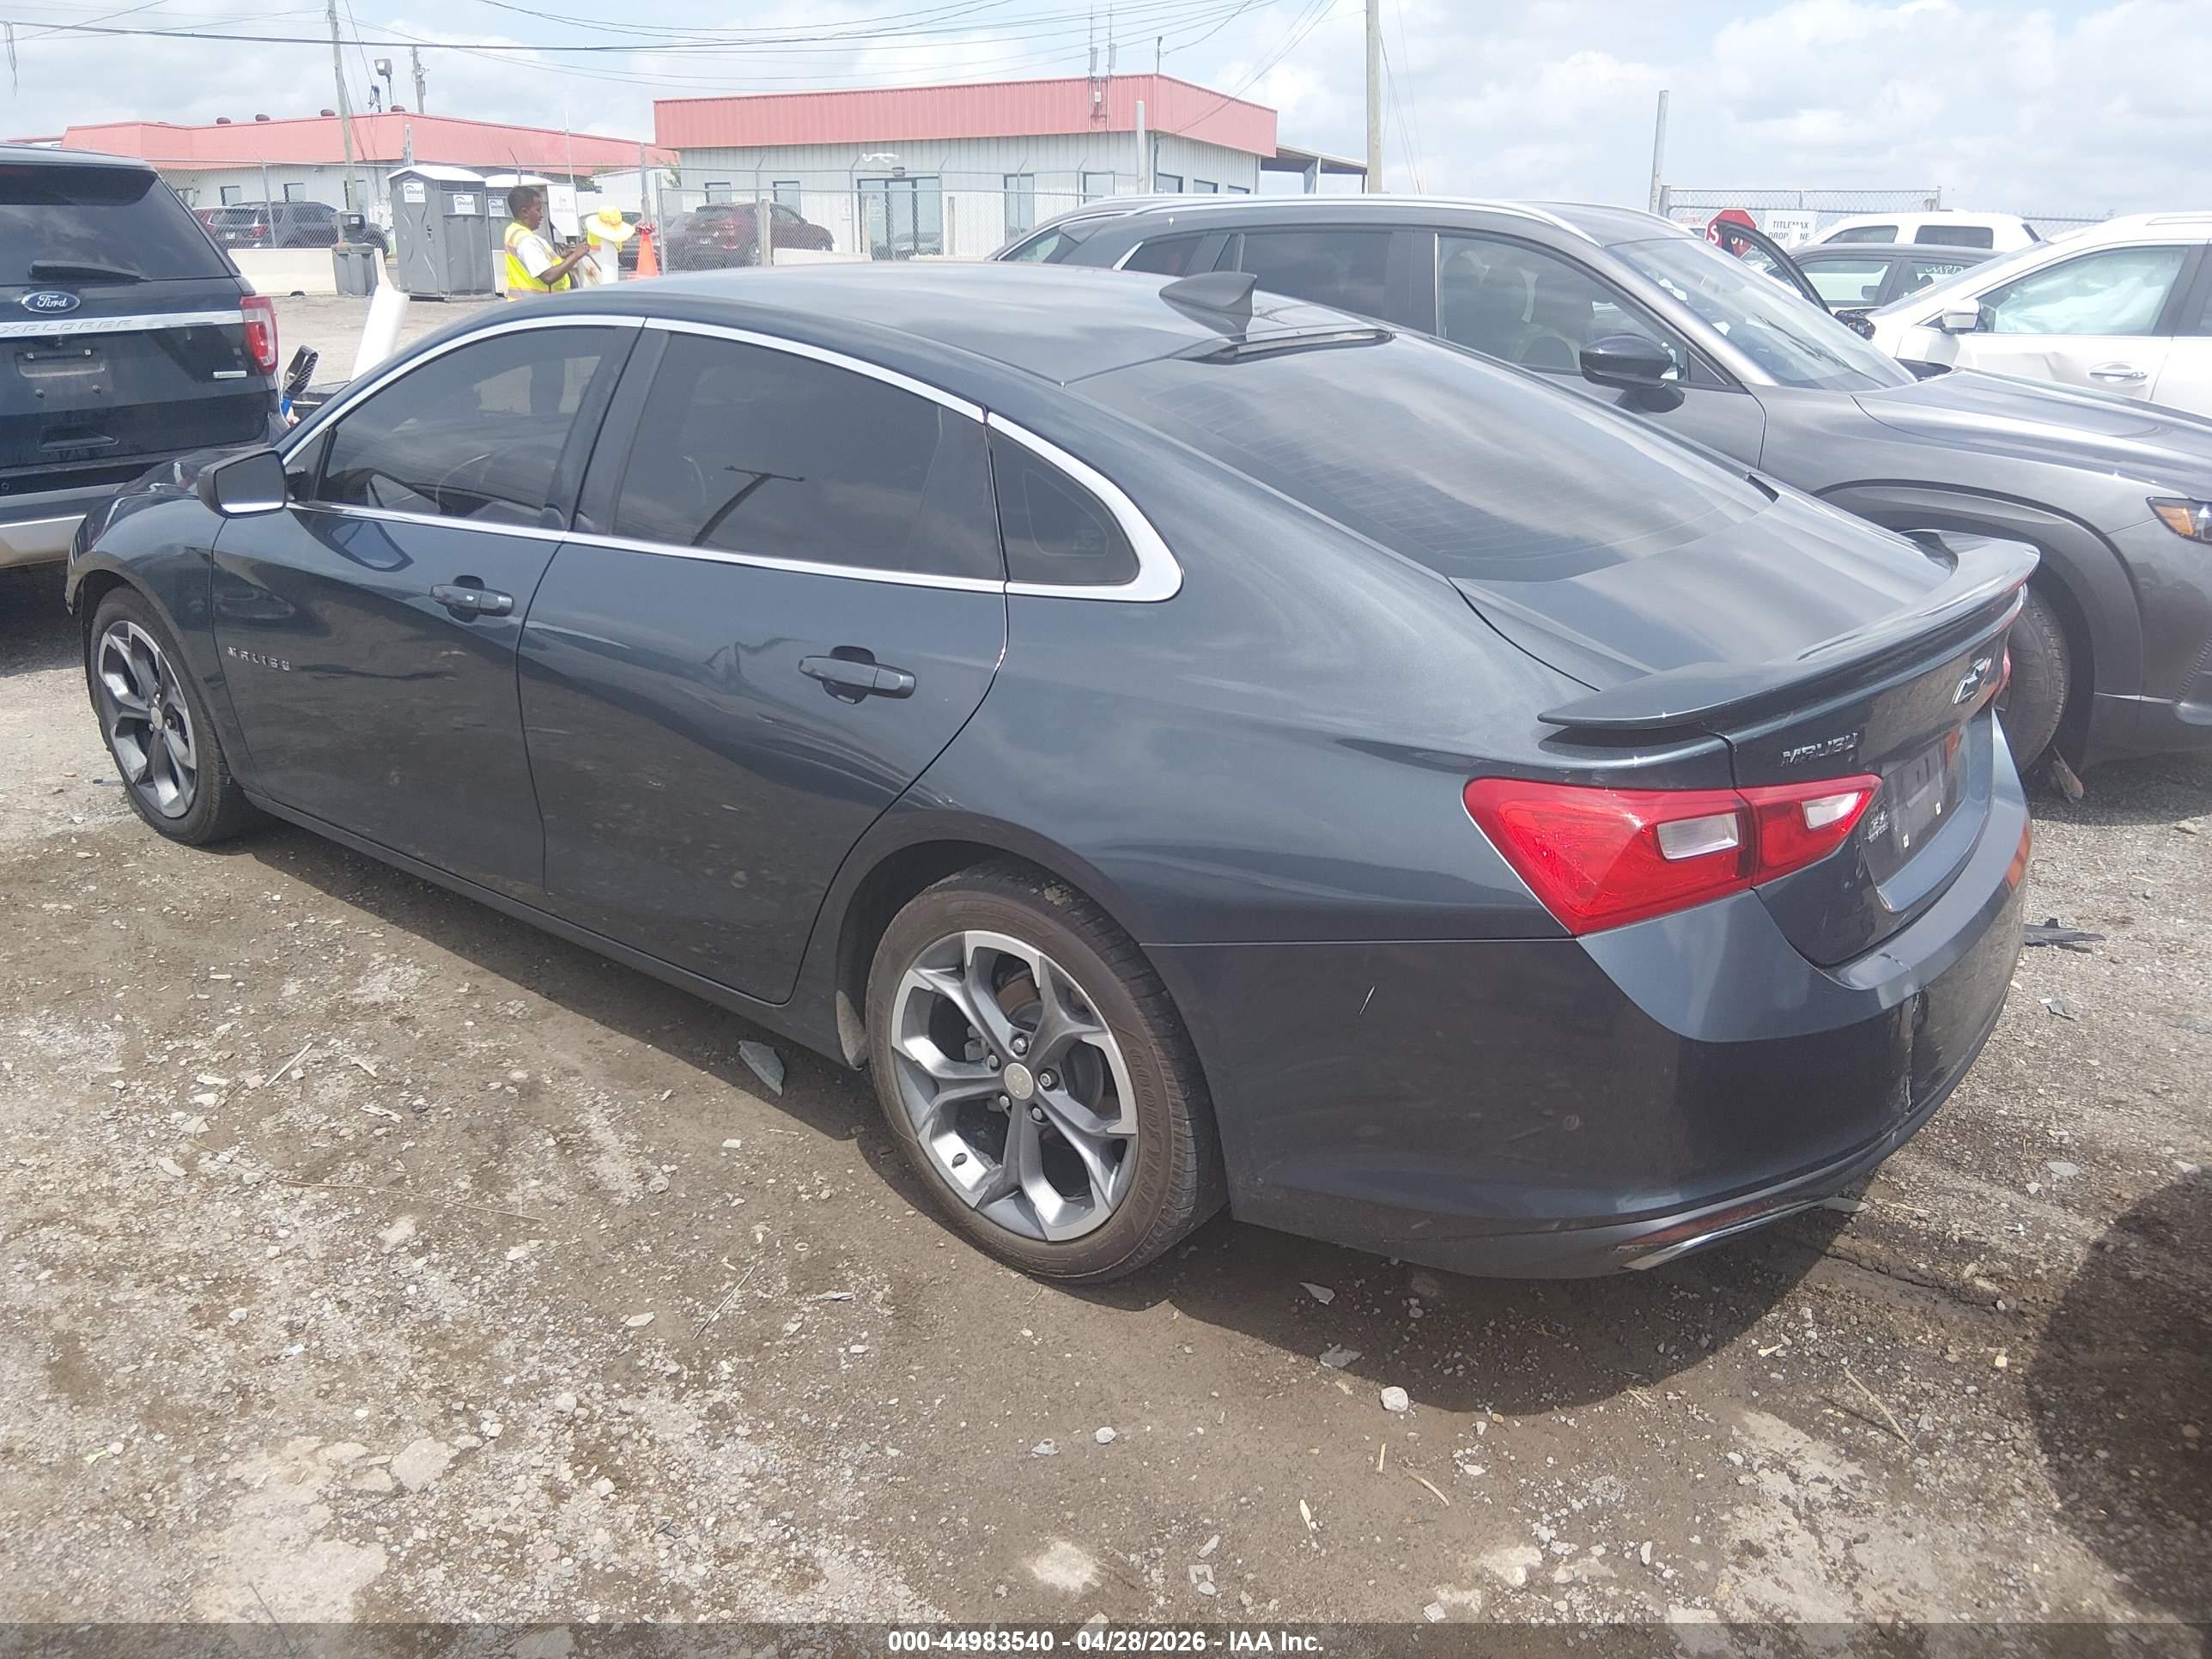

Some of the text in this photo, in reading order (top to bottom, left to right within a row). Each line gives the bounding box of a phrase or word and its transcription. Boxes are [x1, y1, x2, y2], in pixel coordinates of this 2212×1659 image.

[1768, 232, 1789, 240] DROP
[37, 295, 68, 307] Ford
[0, 319, 132, 334] XPLORER
[227, 647, 290, 672] MALIBU
[1781, 732, 1858, 767] MALIBU
